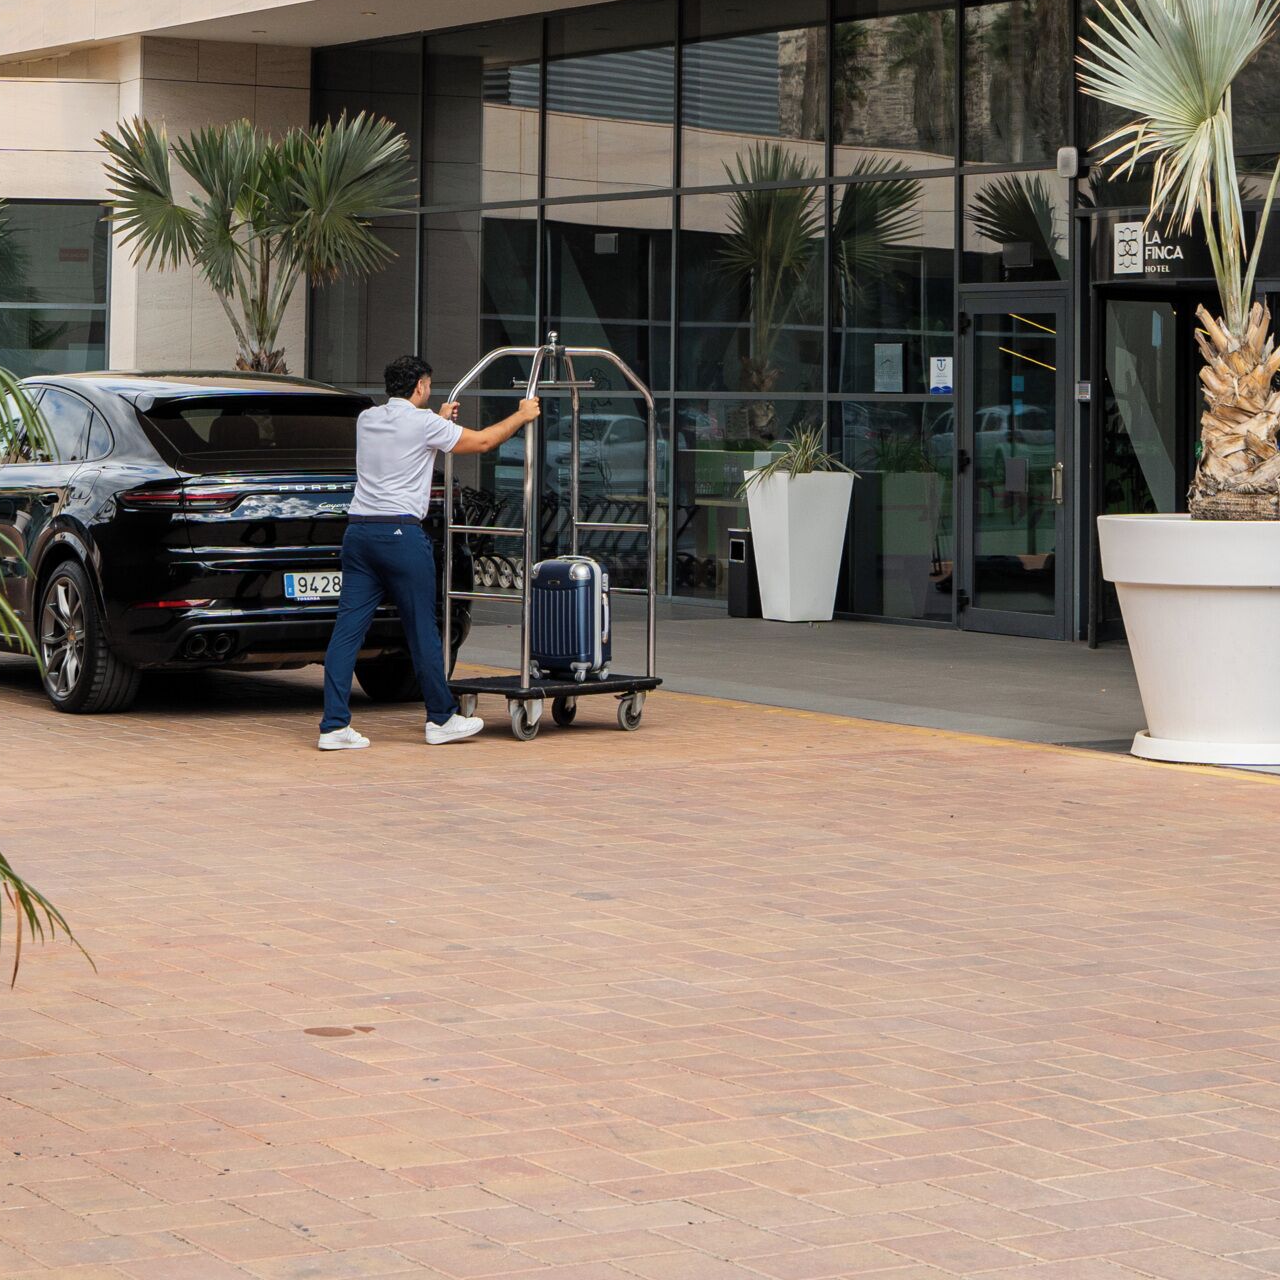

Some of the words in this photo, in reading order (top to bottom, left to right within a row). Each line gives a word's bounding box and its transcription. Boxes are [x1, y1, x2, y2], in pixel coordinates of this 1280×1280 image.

[1145, 230, 1161, 245] LA
[1145, 245, 1184, 260] FINCA
[1145, 265, 1170, 273] HOTEL
[298, 576, 342, 594] 9428
